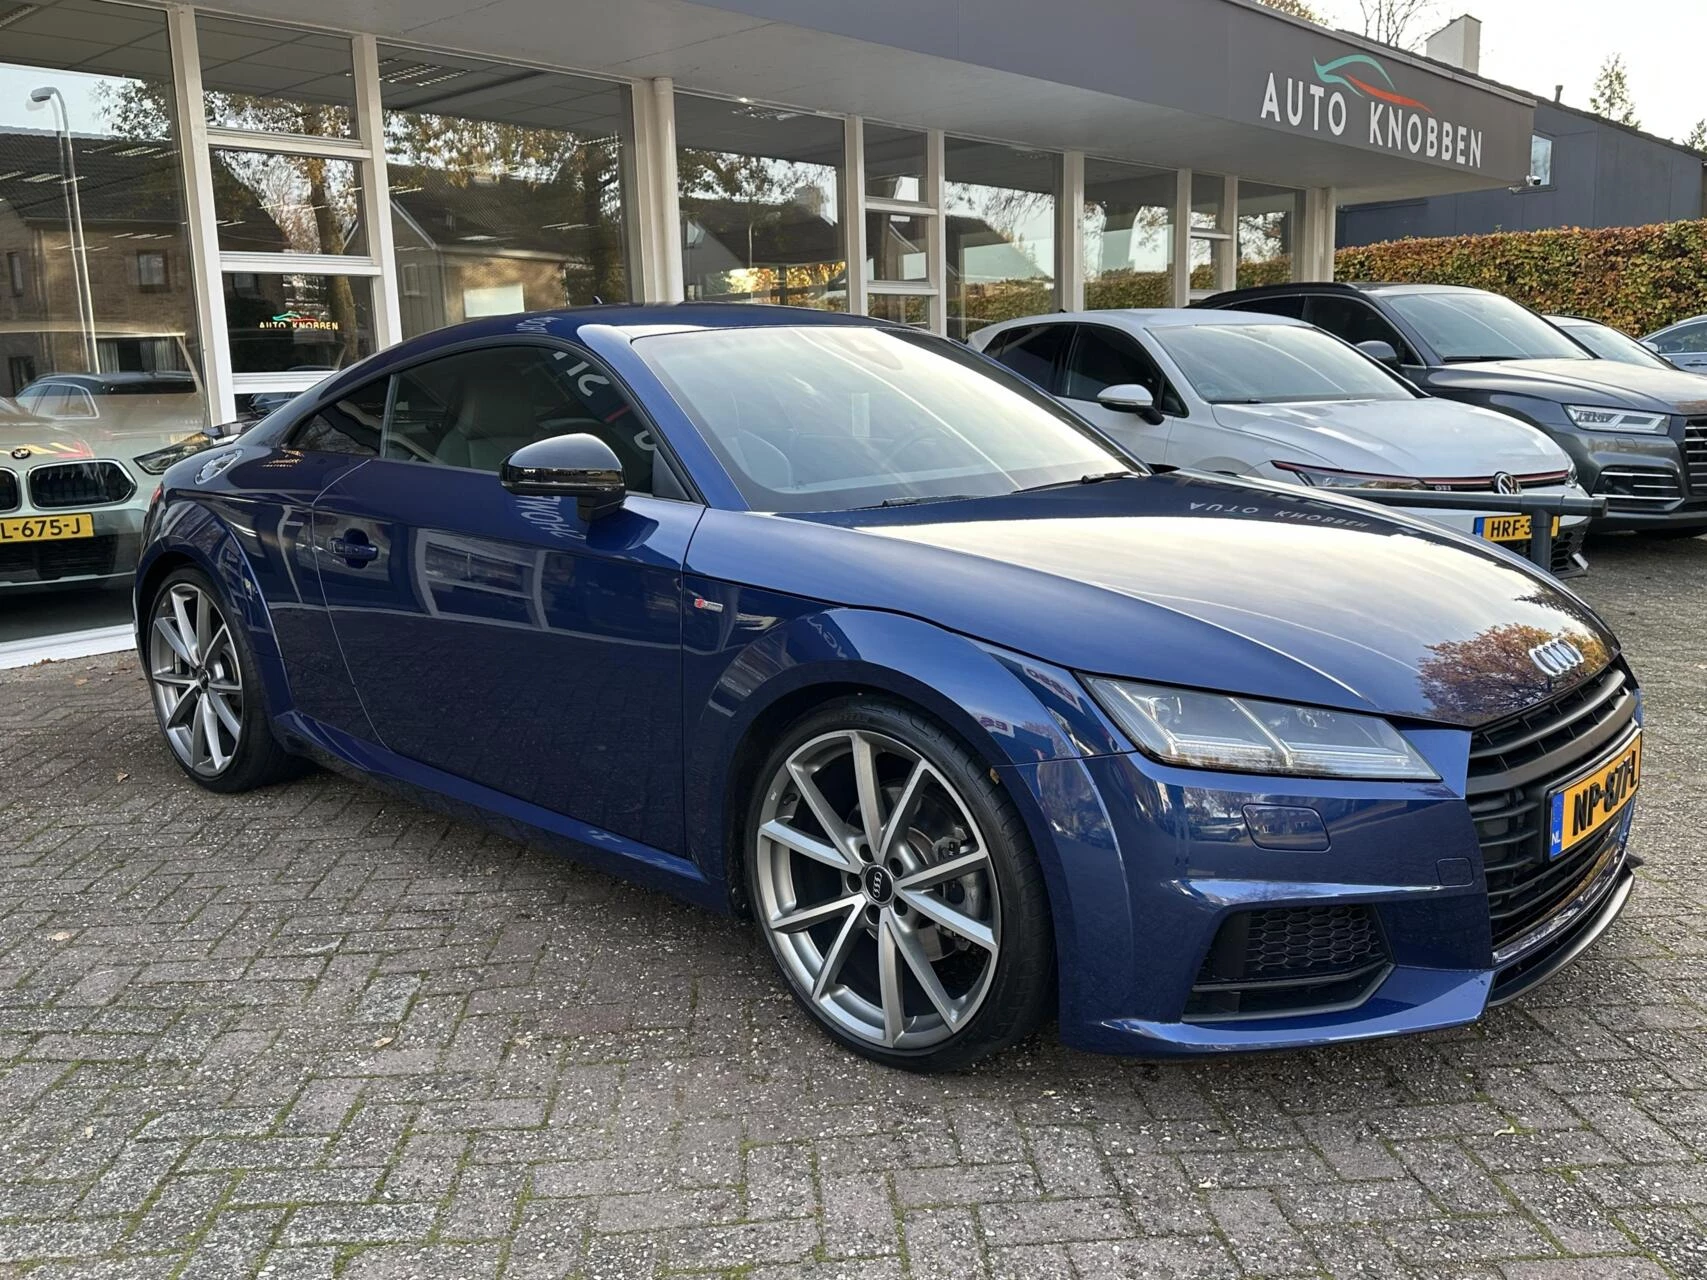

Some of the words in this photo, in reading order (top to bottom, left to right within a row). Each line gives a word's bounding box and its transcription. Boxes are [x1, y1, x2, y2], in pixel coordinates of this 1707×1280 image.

[1260, 72, 1347, 136] AUTO
[1369, 101, 1483, 169] KNOBBEN
[259, 321, 287, 329] AUTO
[0, 517, 81, 539] L-675-J
[1490, 519, 1532, 538] HRF-3
[1572, 750, 1638, 836] NP-877-L
[1551, 830, 1561, 846] NL
